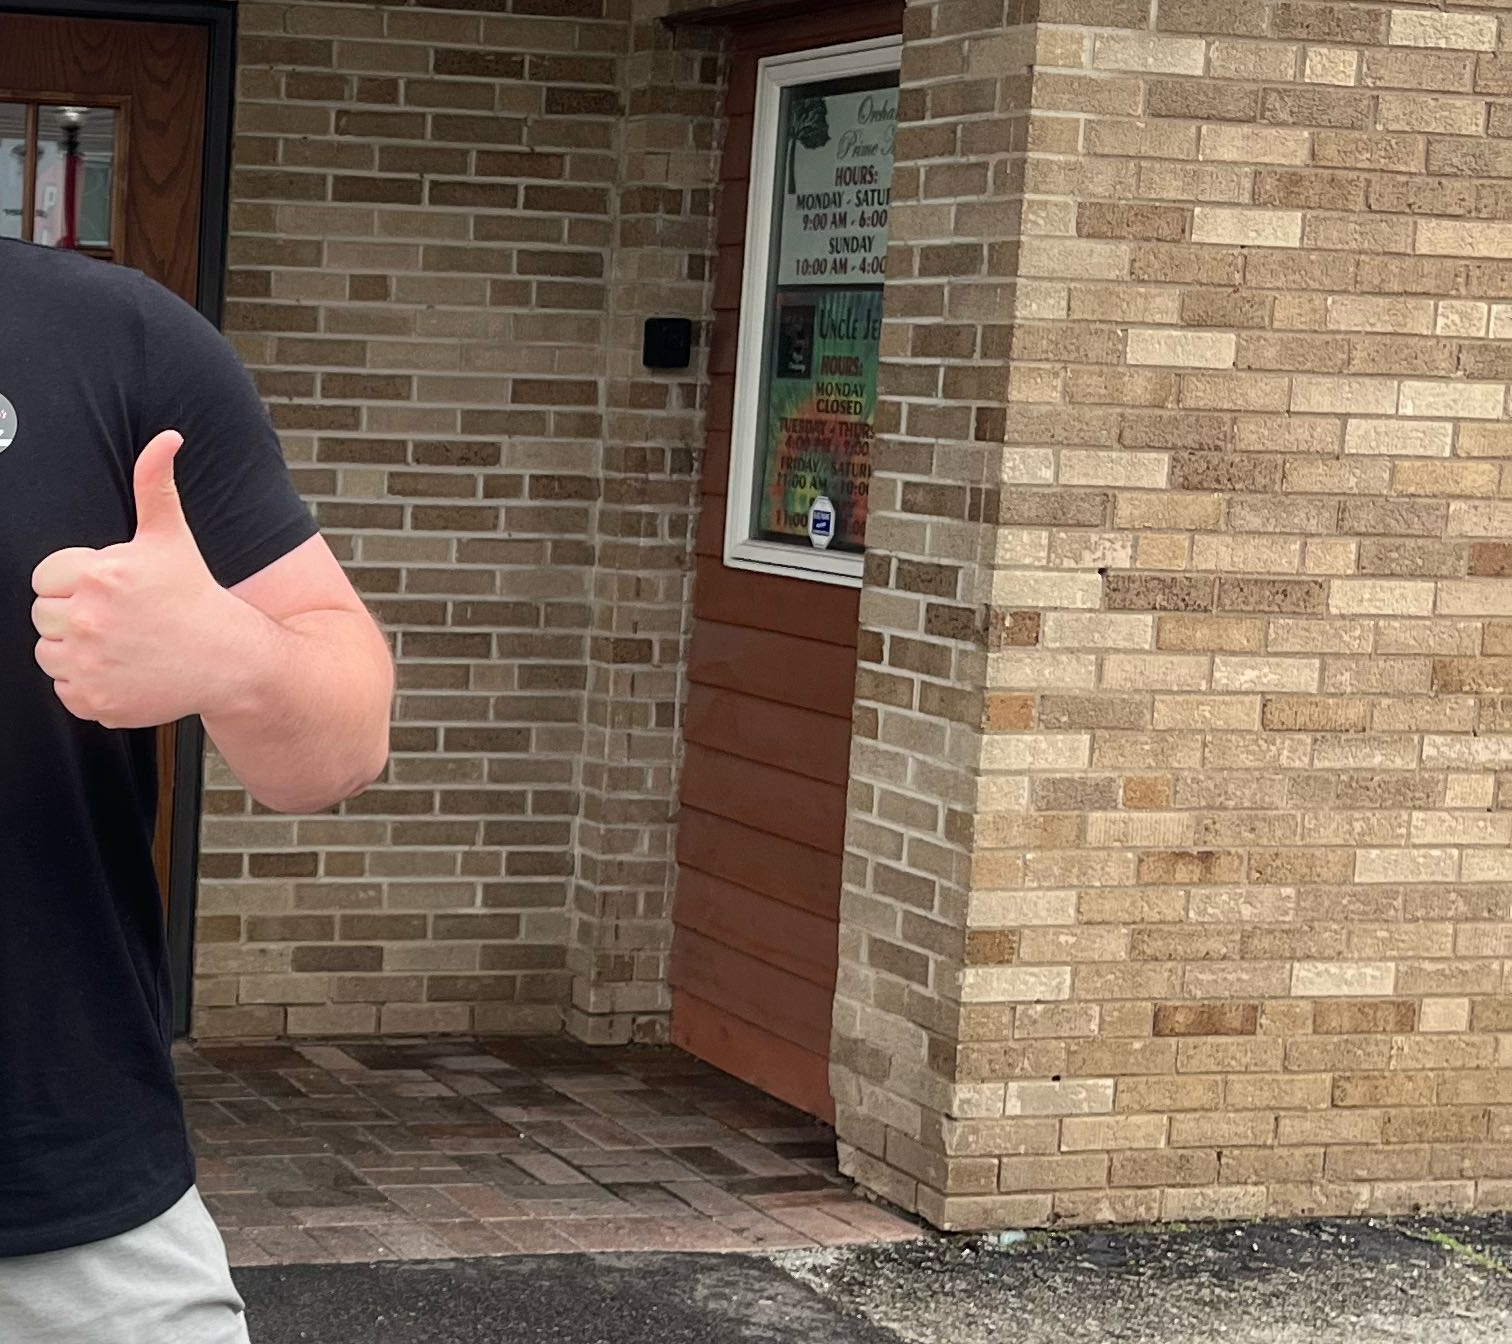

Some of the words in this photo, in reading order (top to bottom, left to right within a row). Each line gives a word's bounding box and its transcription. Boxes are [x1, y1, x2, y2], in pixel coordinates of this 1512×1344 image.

[834, 164, 879, 187] HOURS:
[796, 191, 844, 210] MONDAY
[802, 212, 827, 232] 9:00
[829, 211, 848, 229] AM
[859, 209, 888, 228] 6:00
[828, 235, 875, 255] SUNDAY
[795, 258, 828, 276] 10:00
[829, 257, 848, 275] AM
[816, 381, 866, 398] MONDAY
[816, 398, 863, 416] CLOSED
[780, 455, 820, 473] FRIDAY
